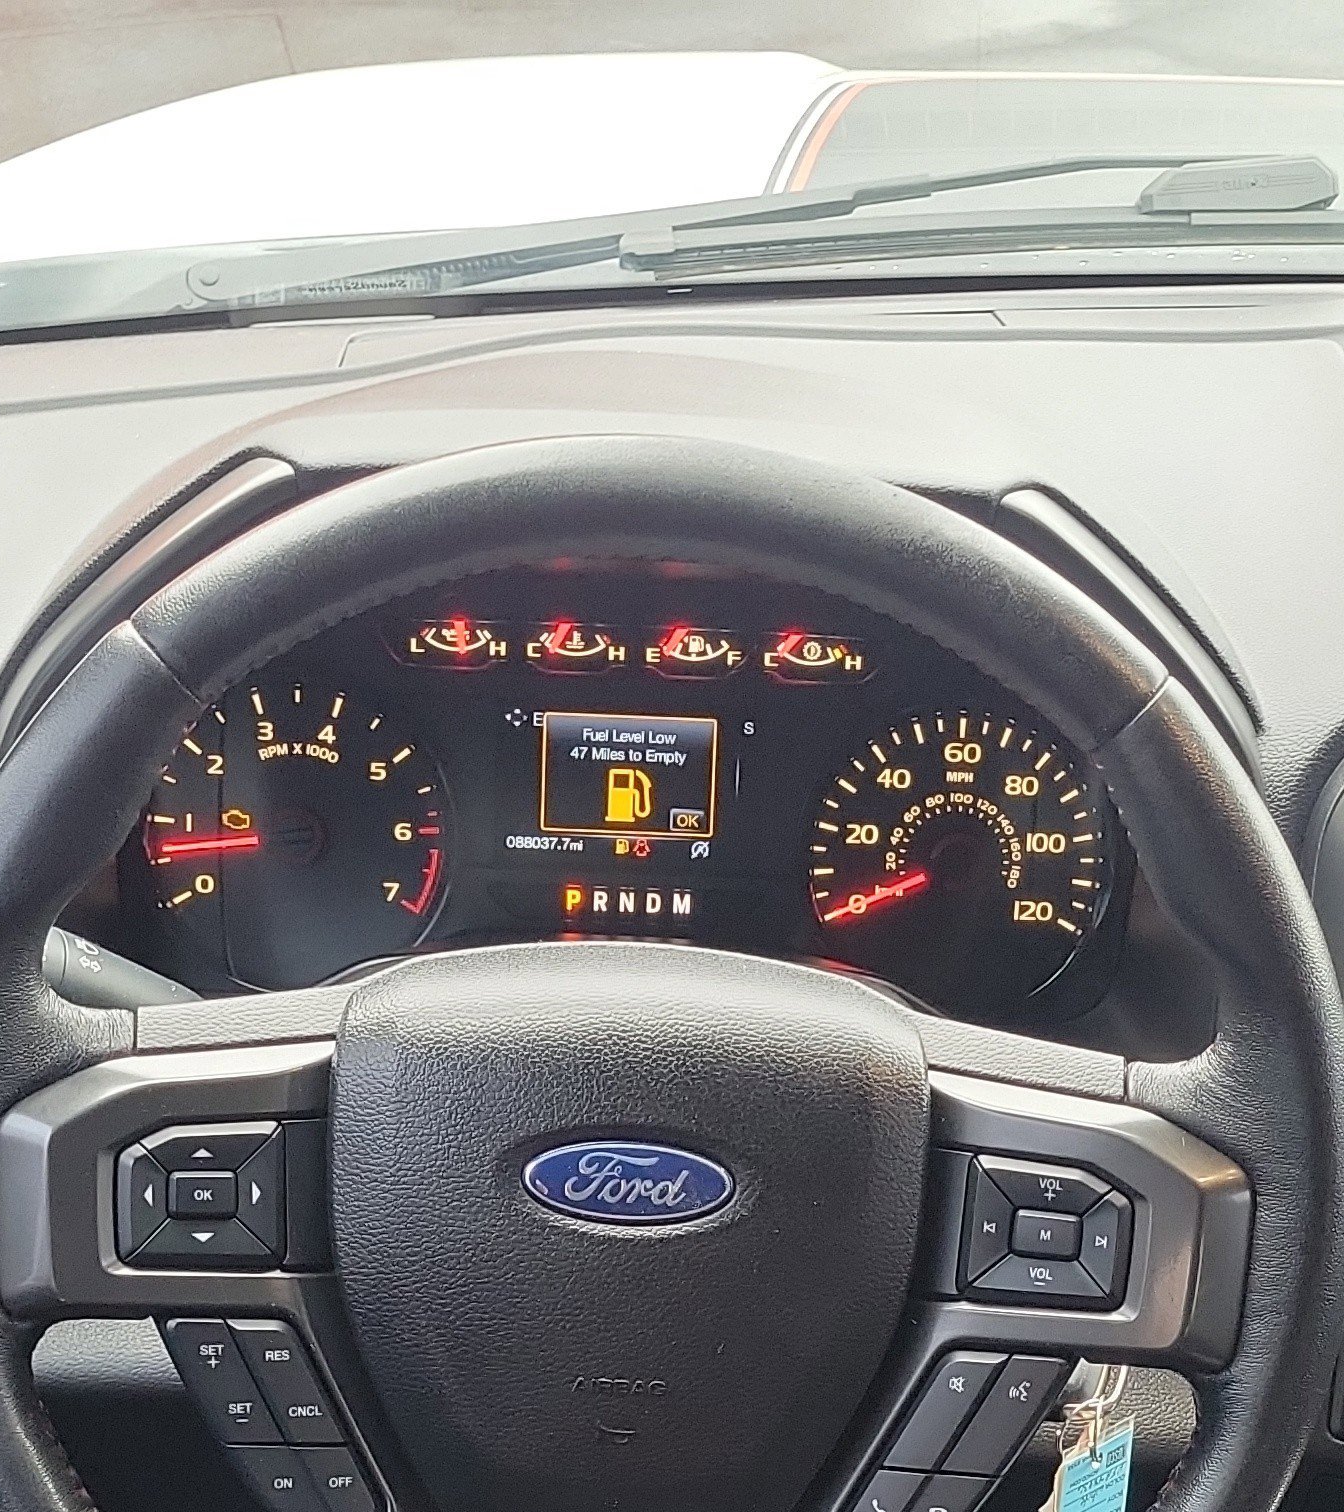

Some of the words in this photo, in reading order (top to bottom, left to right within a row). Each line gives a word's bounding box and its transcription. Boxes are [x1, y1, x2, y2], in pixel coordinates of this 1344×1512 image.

[410, 637, 426, 653] L
[489, 641, 506, 656] H
[527, 643, 542, 658] C
[608, 646, 625, 661] H
[646, 648, 660, 663] E
[727, 650, 742, 667] F
[845, 655, 861, 671] H
[257, 722, 274, 740] 3
[317, 725, 337, 744] 4
[582, 728, 608, 742] Fuel
[612, 729, 644, 743] Level
[649, 731, 677, 745] Low
[258, 743, 289, 761] RPM
[292, 743, 303, 755] X
[305, 744, 339, 764] 1000
[570, 747, 588, 760] 47
[591, 747, 625, 761] Miles
[629, 749, 642, 761] to
[645, 750, 687, 766] Empty
[944, 743, 981, 764] 60
[206, 755, 224, 774] 2
[369, 762, 387, 781] 5
[876, 769, 911, 789] 40
[946, 771, 974, 783] MPH
[1004, 775, 1040, 796] 80
[925, 794, 945, 808] 80
[950, 793, 974, 805] 100
[976, 798, 998, 815] 120
[676, 814, 700, 828] OK
[903, 805, 921, 823] 60
[393, 823, 412, 841] 6
[845, 823, 879, 844] 20
[996, 814, 1015, 836] 140
[890, 827, 904, 846] 40
[1026, 832, 1065, 853] 100
[1009, 837, 1022, 861] 160
[885, 851, 896, 870] 20
[195, 875, 214, 894] 0
[1007, 865, 1022, 889] 180
[383, 882, 401, 902] 7
[566, 890, 582, 911] P
[593, 891, 608, 912] R
[619, 892, 634, 913] N
[646, 893, 662, 914] D
[673, 894, 691, 915] M
[1013, 901, 1054, 922] 120
[564, 1150, 690, 1208] Ford
[1038, 1177, 1063, 1191] VOL
[194, 1189, 214, 1202] OK
[1040, 1229, 1051, 1242] M
[1029, 1266, 1053, 1281] VOL
[199, 1344, 225, 1357] SET
[265, 1349, 290, 1362] RES
[228, 1402, 253, 1415] SET
[288, 1404, 323, 1417] CNCL
[273, 1477, 293, 1489] ON
[329, 1476, 353, 1489] OFF
